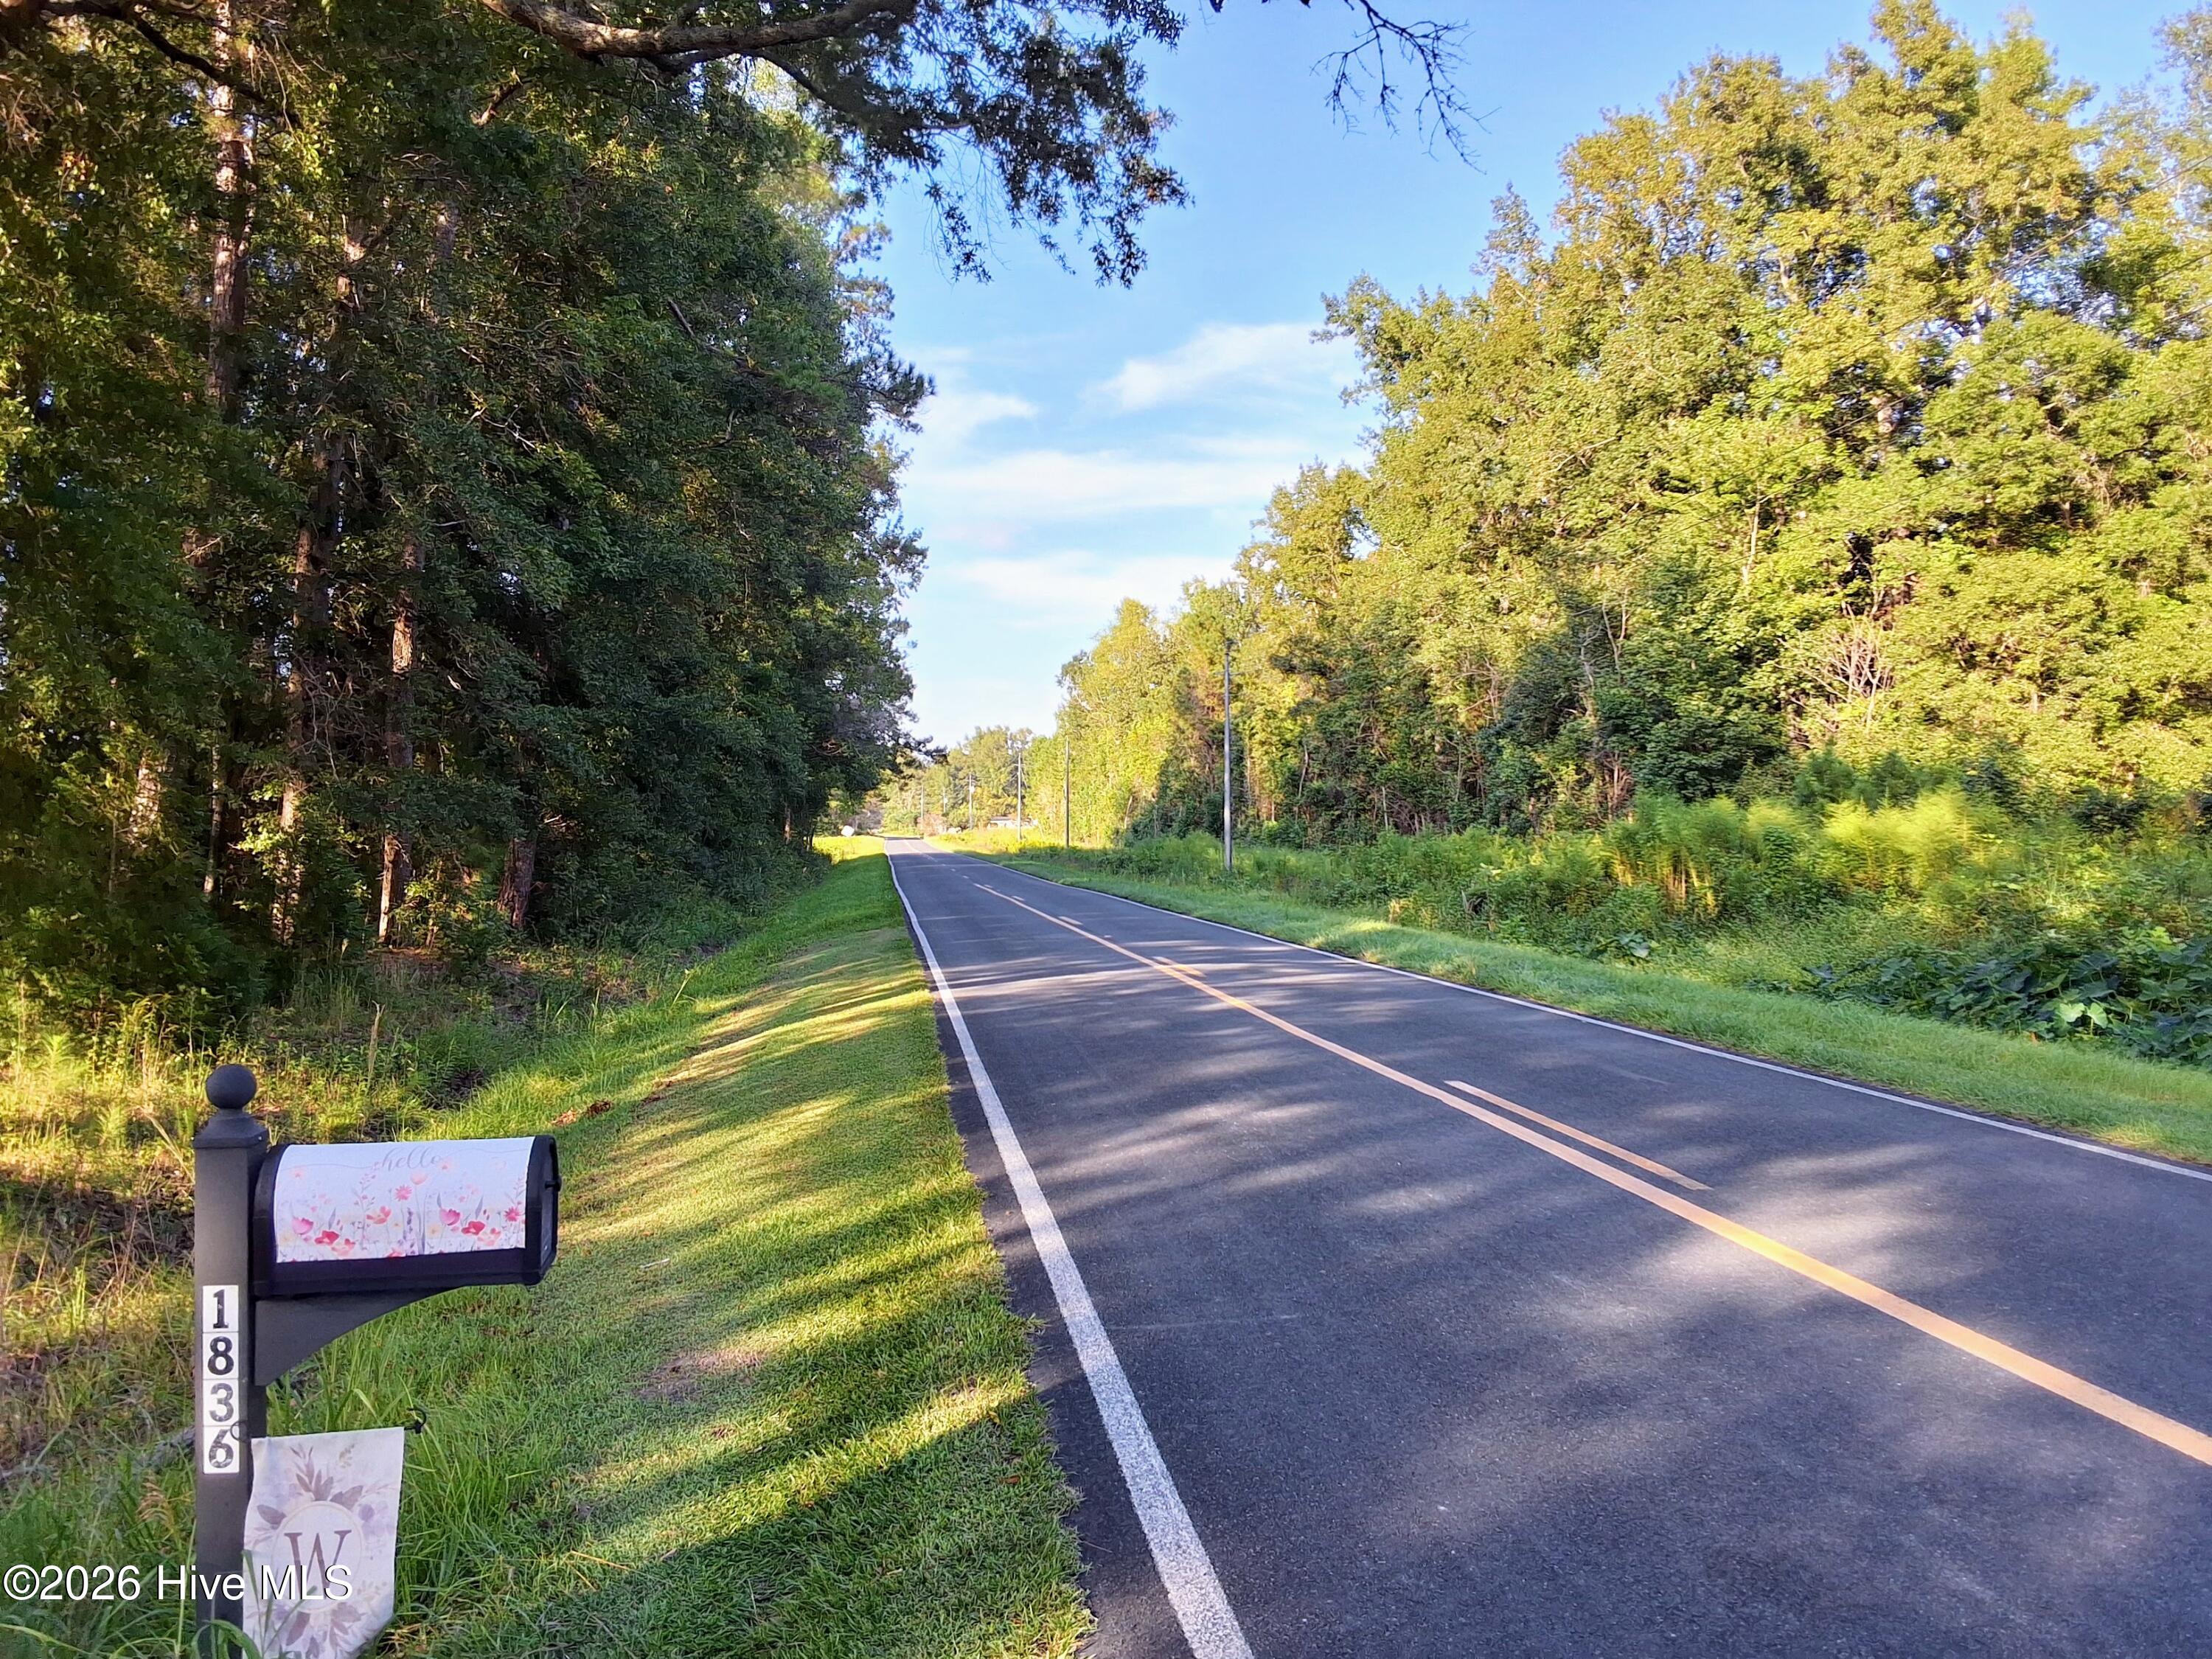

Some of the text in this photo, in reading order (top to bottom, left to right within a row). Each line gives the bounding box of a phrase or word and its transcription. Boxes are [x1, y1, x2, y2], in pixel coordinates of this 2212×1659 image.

[382, 1145, 442, 1172] hello
[208, 1289, 234, 1469] 1836
[284, 1529, 352, 1599] W
